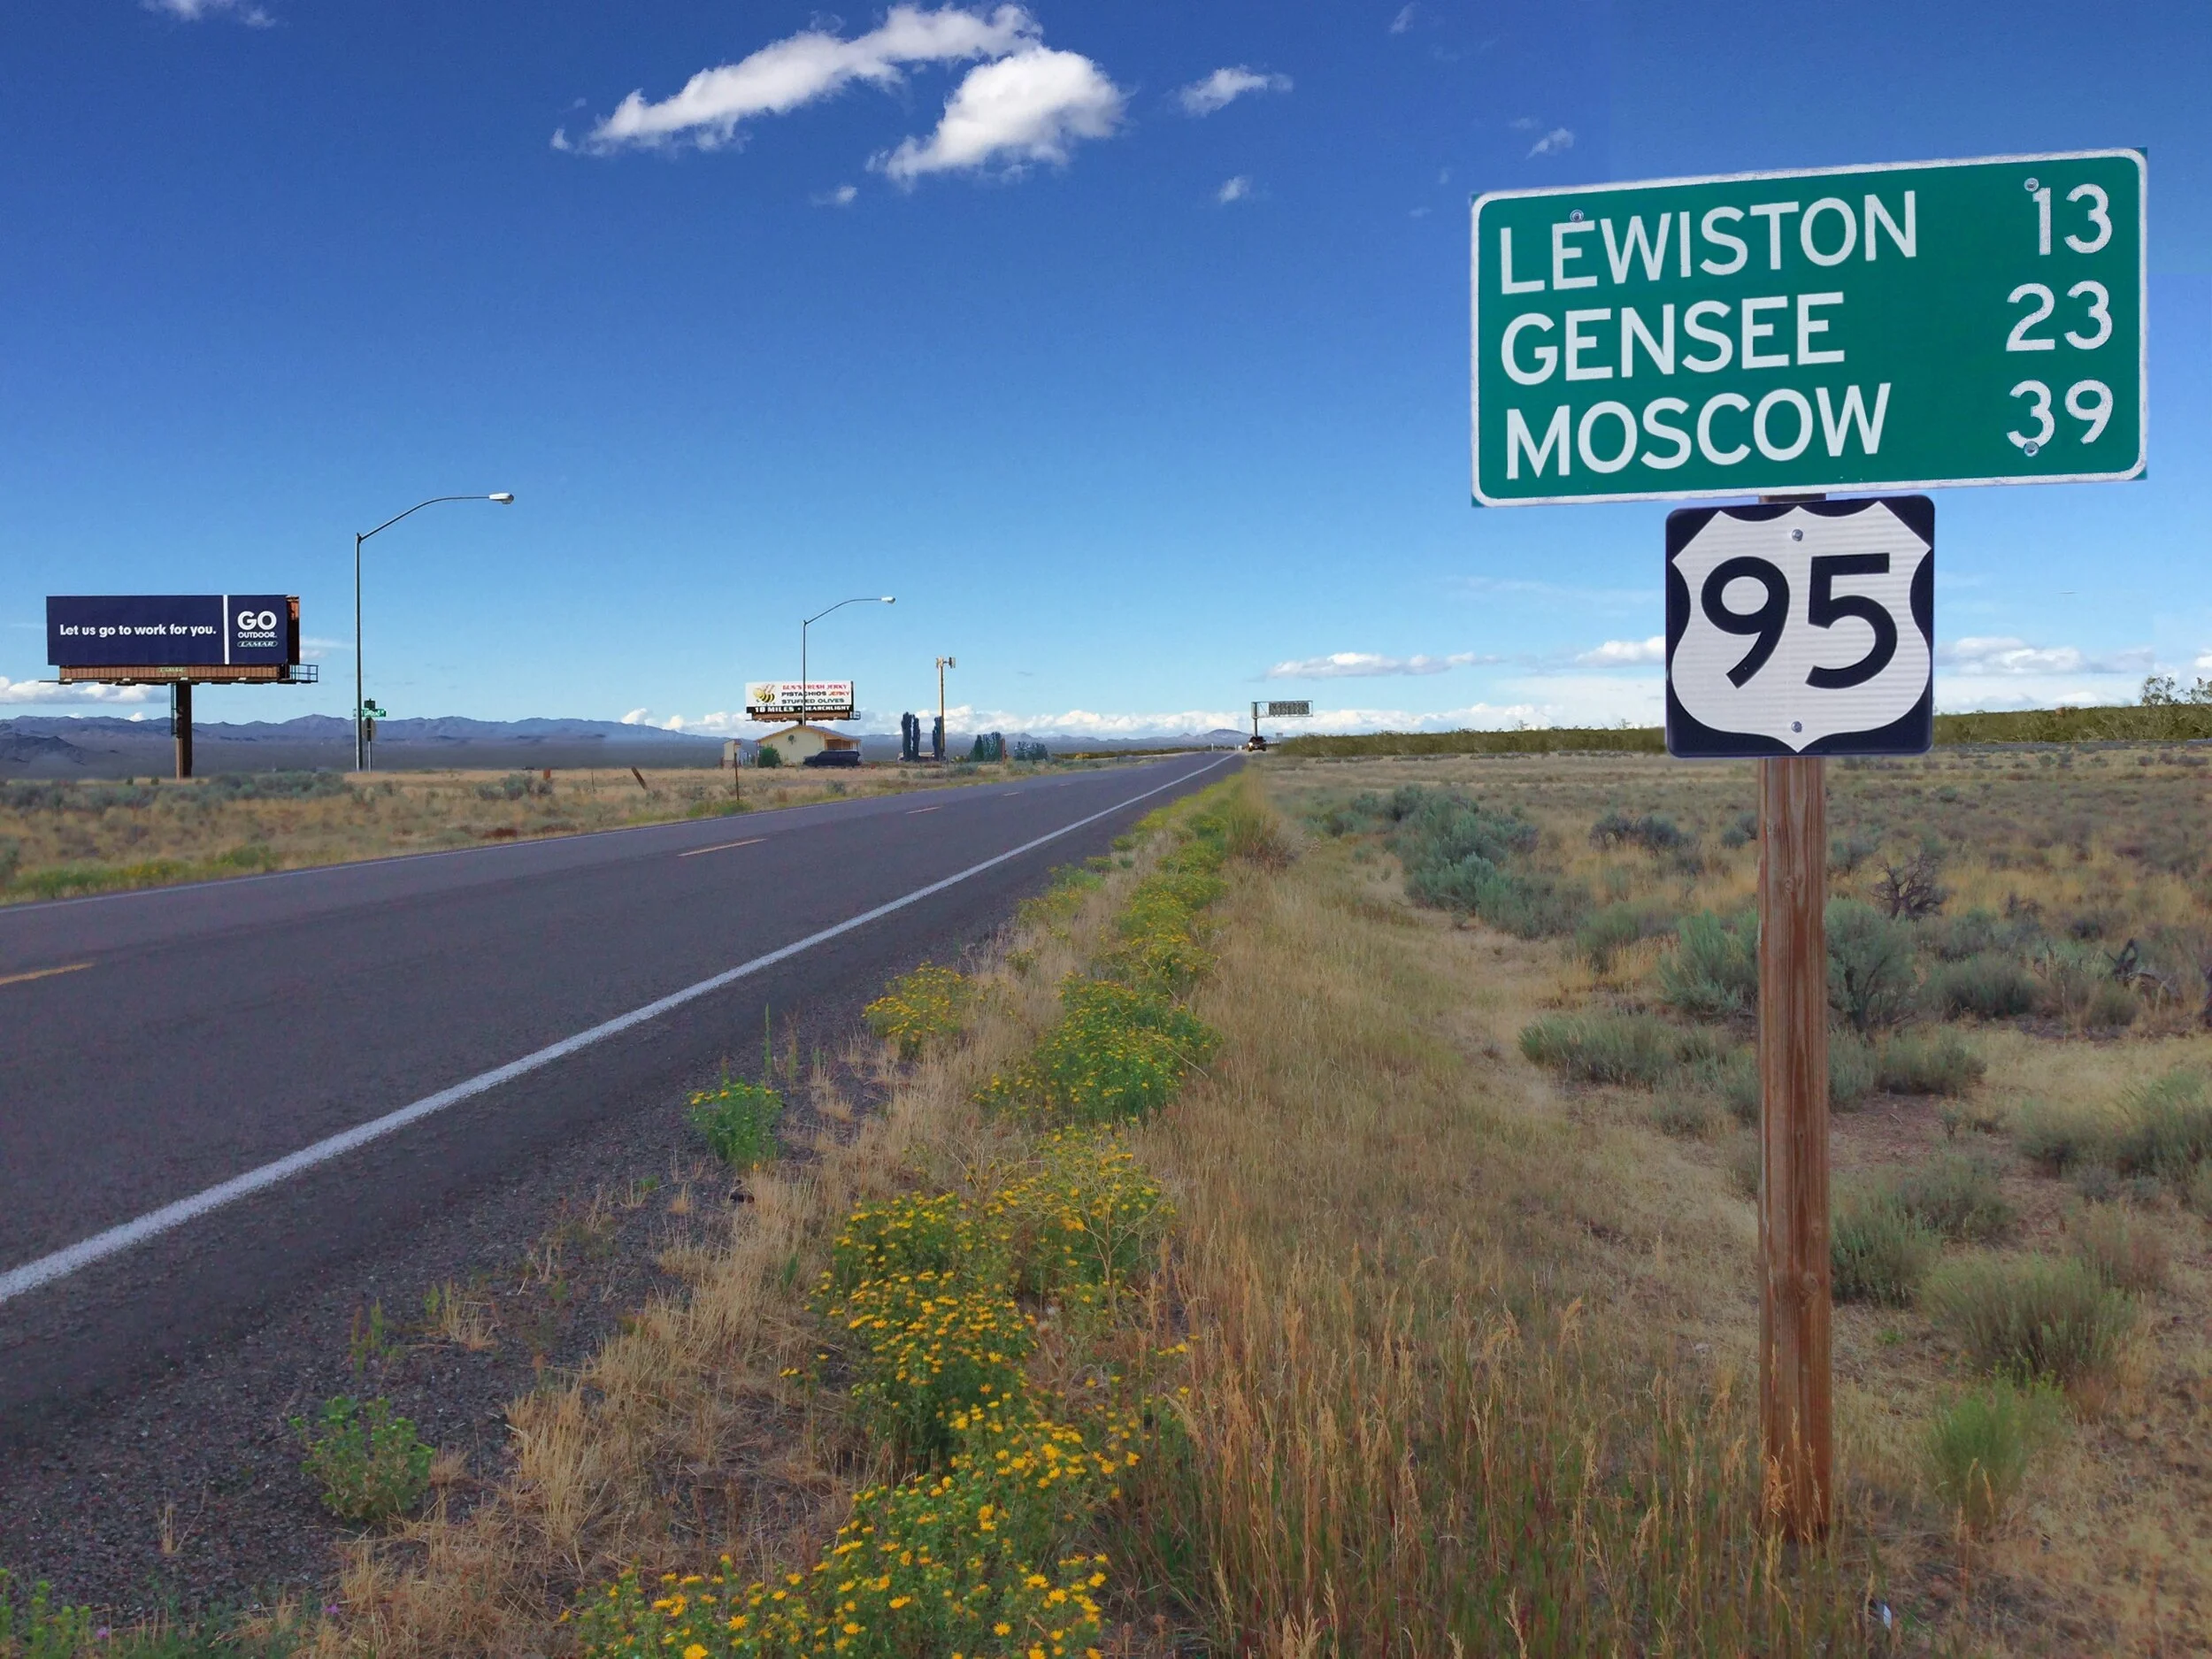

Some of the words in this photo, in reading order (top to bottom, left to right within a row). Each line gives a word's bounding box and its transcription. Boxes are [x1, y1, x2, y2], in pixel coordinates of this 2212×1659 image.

[1501, 191, 1916, 295] LEWISTON
[2032, 184, 2113, 256] 13
[1501, 292, 1845, 386] GENSEE
[2006, 280, 2113, 351] 23
[1507, 383, 1892, 480] MOSCOW
[2008, 380, 2114, 452] 39
[59, 624, 79, 635] Let
[81, 626, 96, 635] us
[99, 626, 116, 638] go
[119, 625, 132, 635] to
[134, 624, 166, 635] work
[169, 623, 188, 634] for
[189, 626, 217, 637] you.
[237, 611, 277, 631] GO
[1701, 553, 1898, 689] 95
